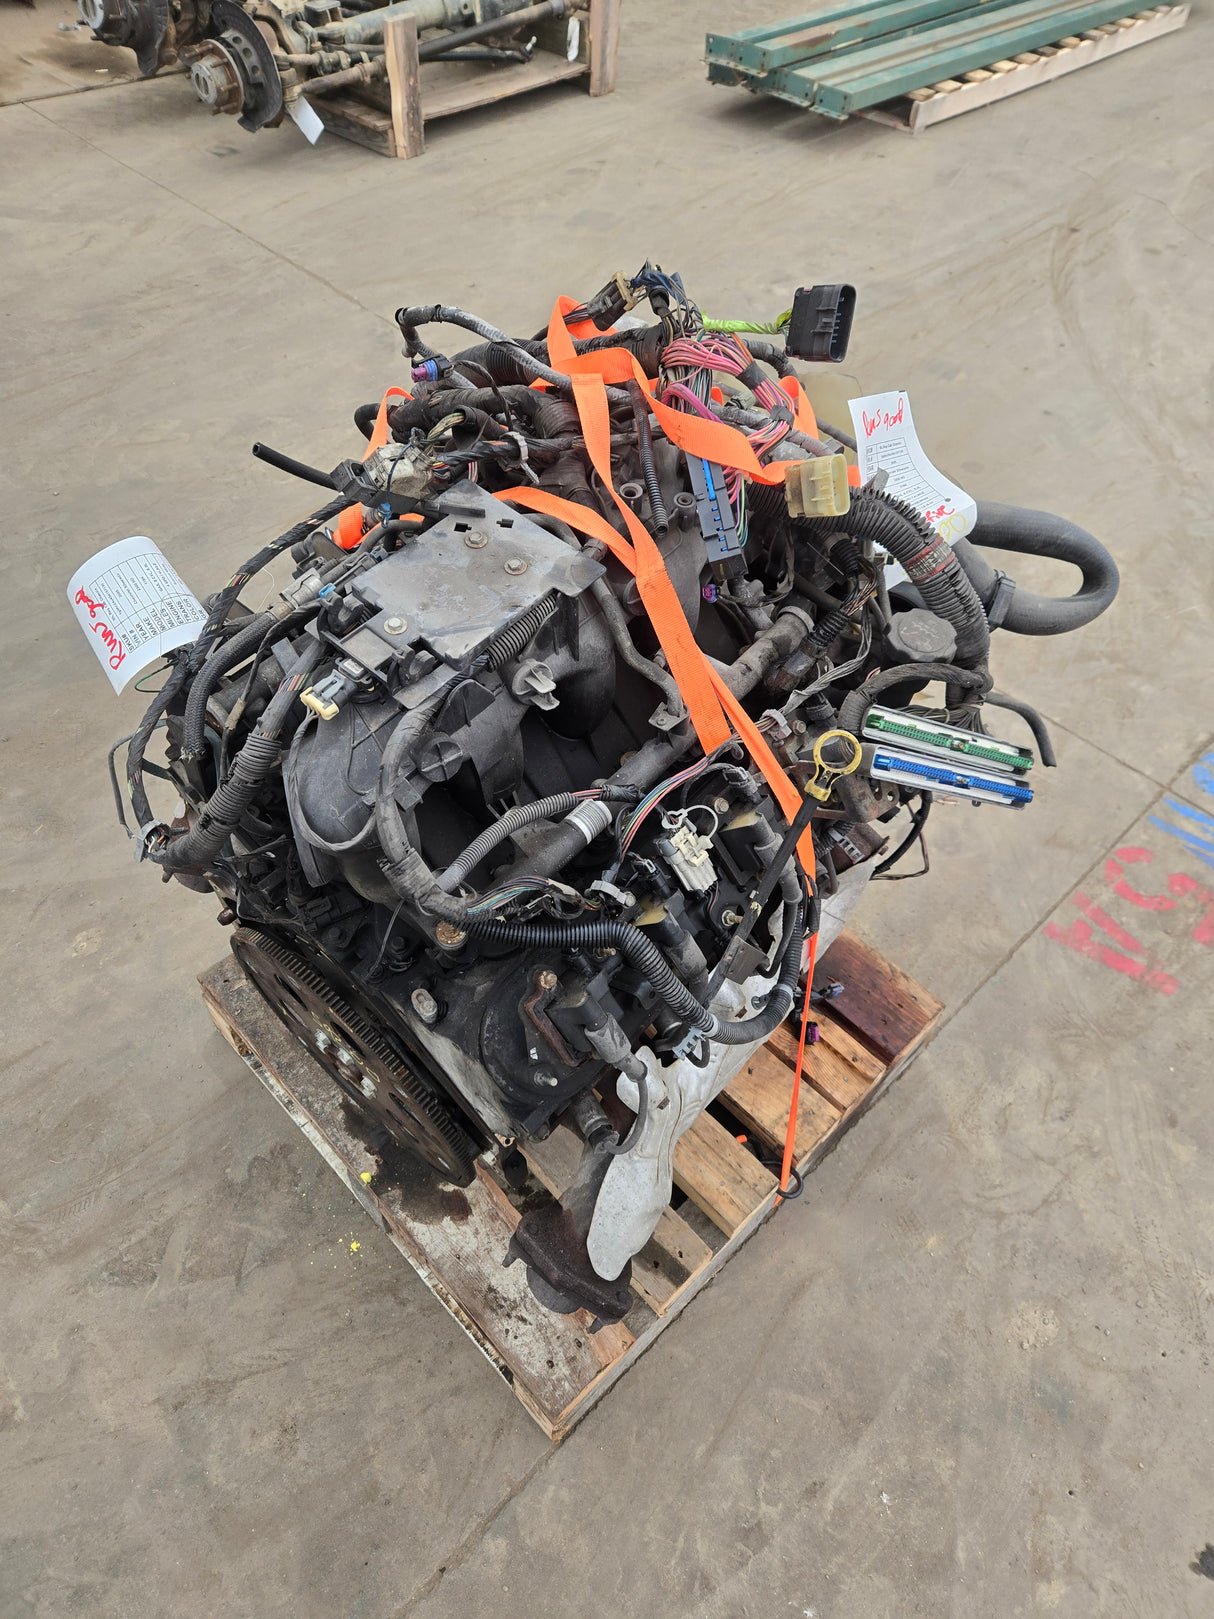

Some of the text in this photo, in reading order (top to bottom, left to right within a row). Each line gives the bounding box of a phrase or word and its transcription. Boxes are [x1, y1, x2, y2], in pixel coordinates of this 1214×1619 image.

[150, 608, 167, 631] MODEL
[160, 608, 175, 627] MILES
[164, 598, 185, 624] ENGINE
[174, 601, 192, 622] TRANS
[181, 598, 199, 620] COLOR
[136, 622, 149, 640] YEAR
[143, 616, 158, 636] MAKE
